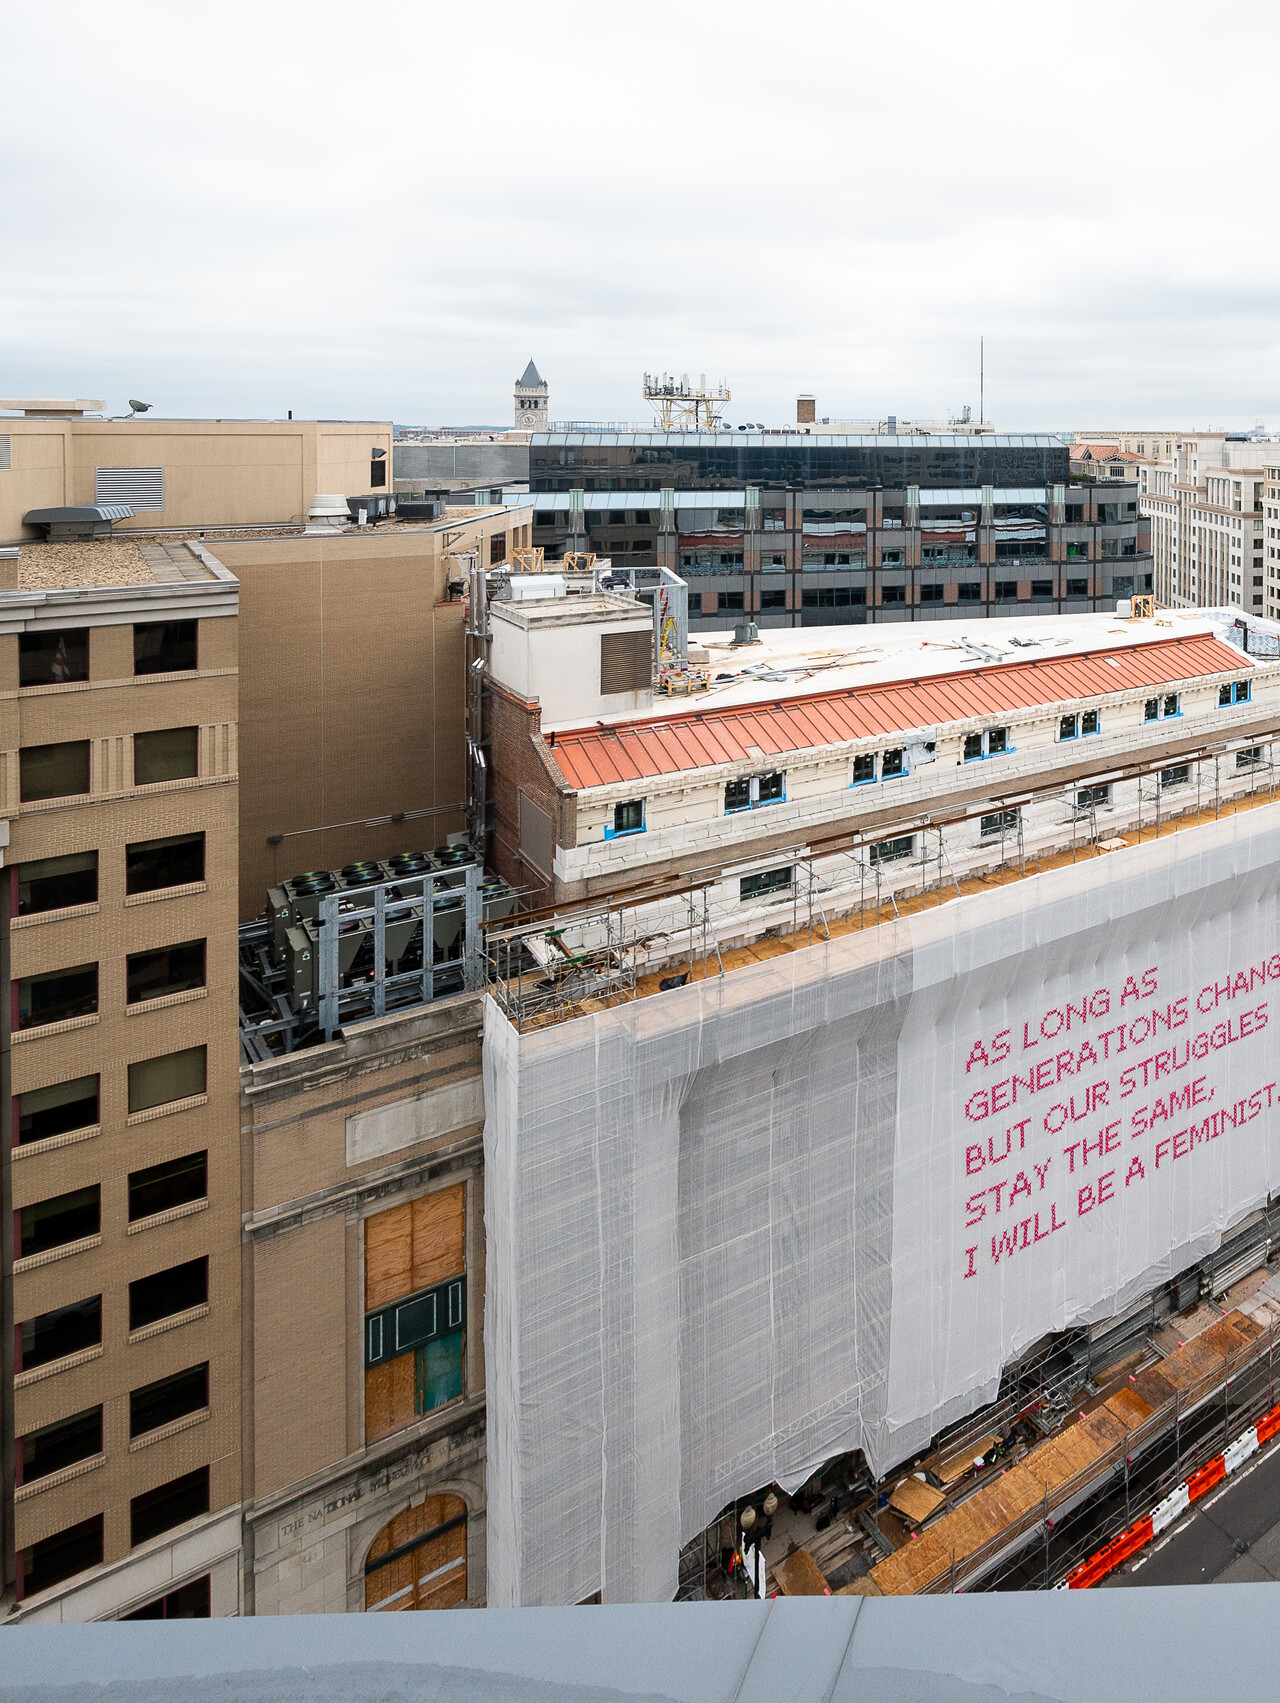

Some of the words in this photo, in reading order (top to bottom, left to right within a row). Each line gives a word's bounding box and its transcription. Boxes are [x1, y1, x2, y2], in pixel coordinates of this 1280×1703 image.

[964, 996, 1189, 1123] GENERATIONS
[965, 1028, 1011, 1073] AS
[1023, 988, 1111, 1050] LONG
[1120, 966, 1158, 1007] AS
[965, 1117, 1032, 1177] BUT
[1043, 1080, 1110, 1135] OUR
[1119, 1002, 1269, 1099] STRUGGLES
[965, 1157, 1052, 1228] STAY
[1063, 1118, 1122, 1173] THE
[1130, 1074, 1216, 1139] SAME,
[963, 1244, 978, 1280] I
[991, 1202, 1067, 1265] WILL
[1077, 1169, 1115, 1217] BE
[1124, 1155, 1146, 1187] A
[281, 1517, 305, 1536] THE
[308, 1488, 365, 1523] NATIONAL
